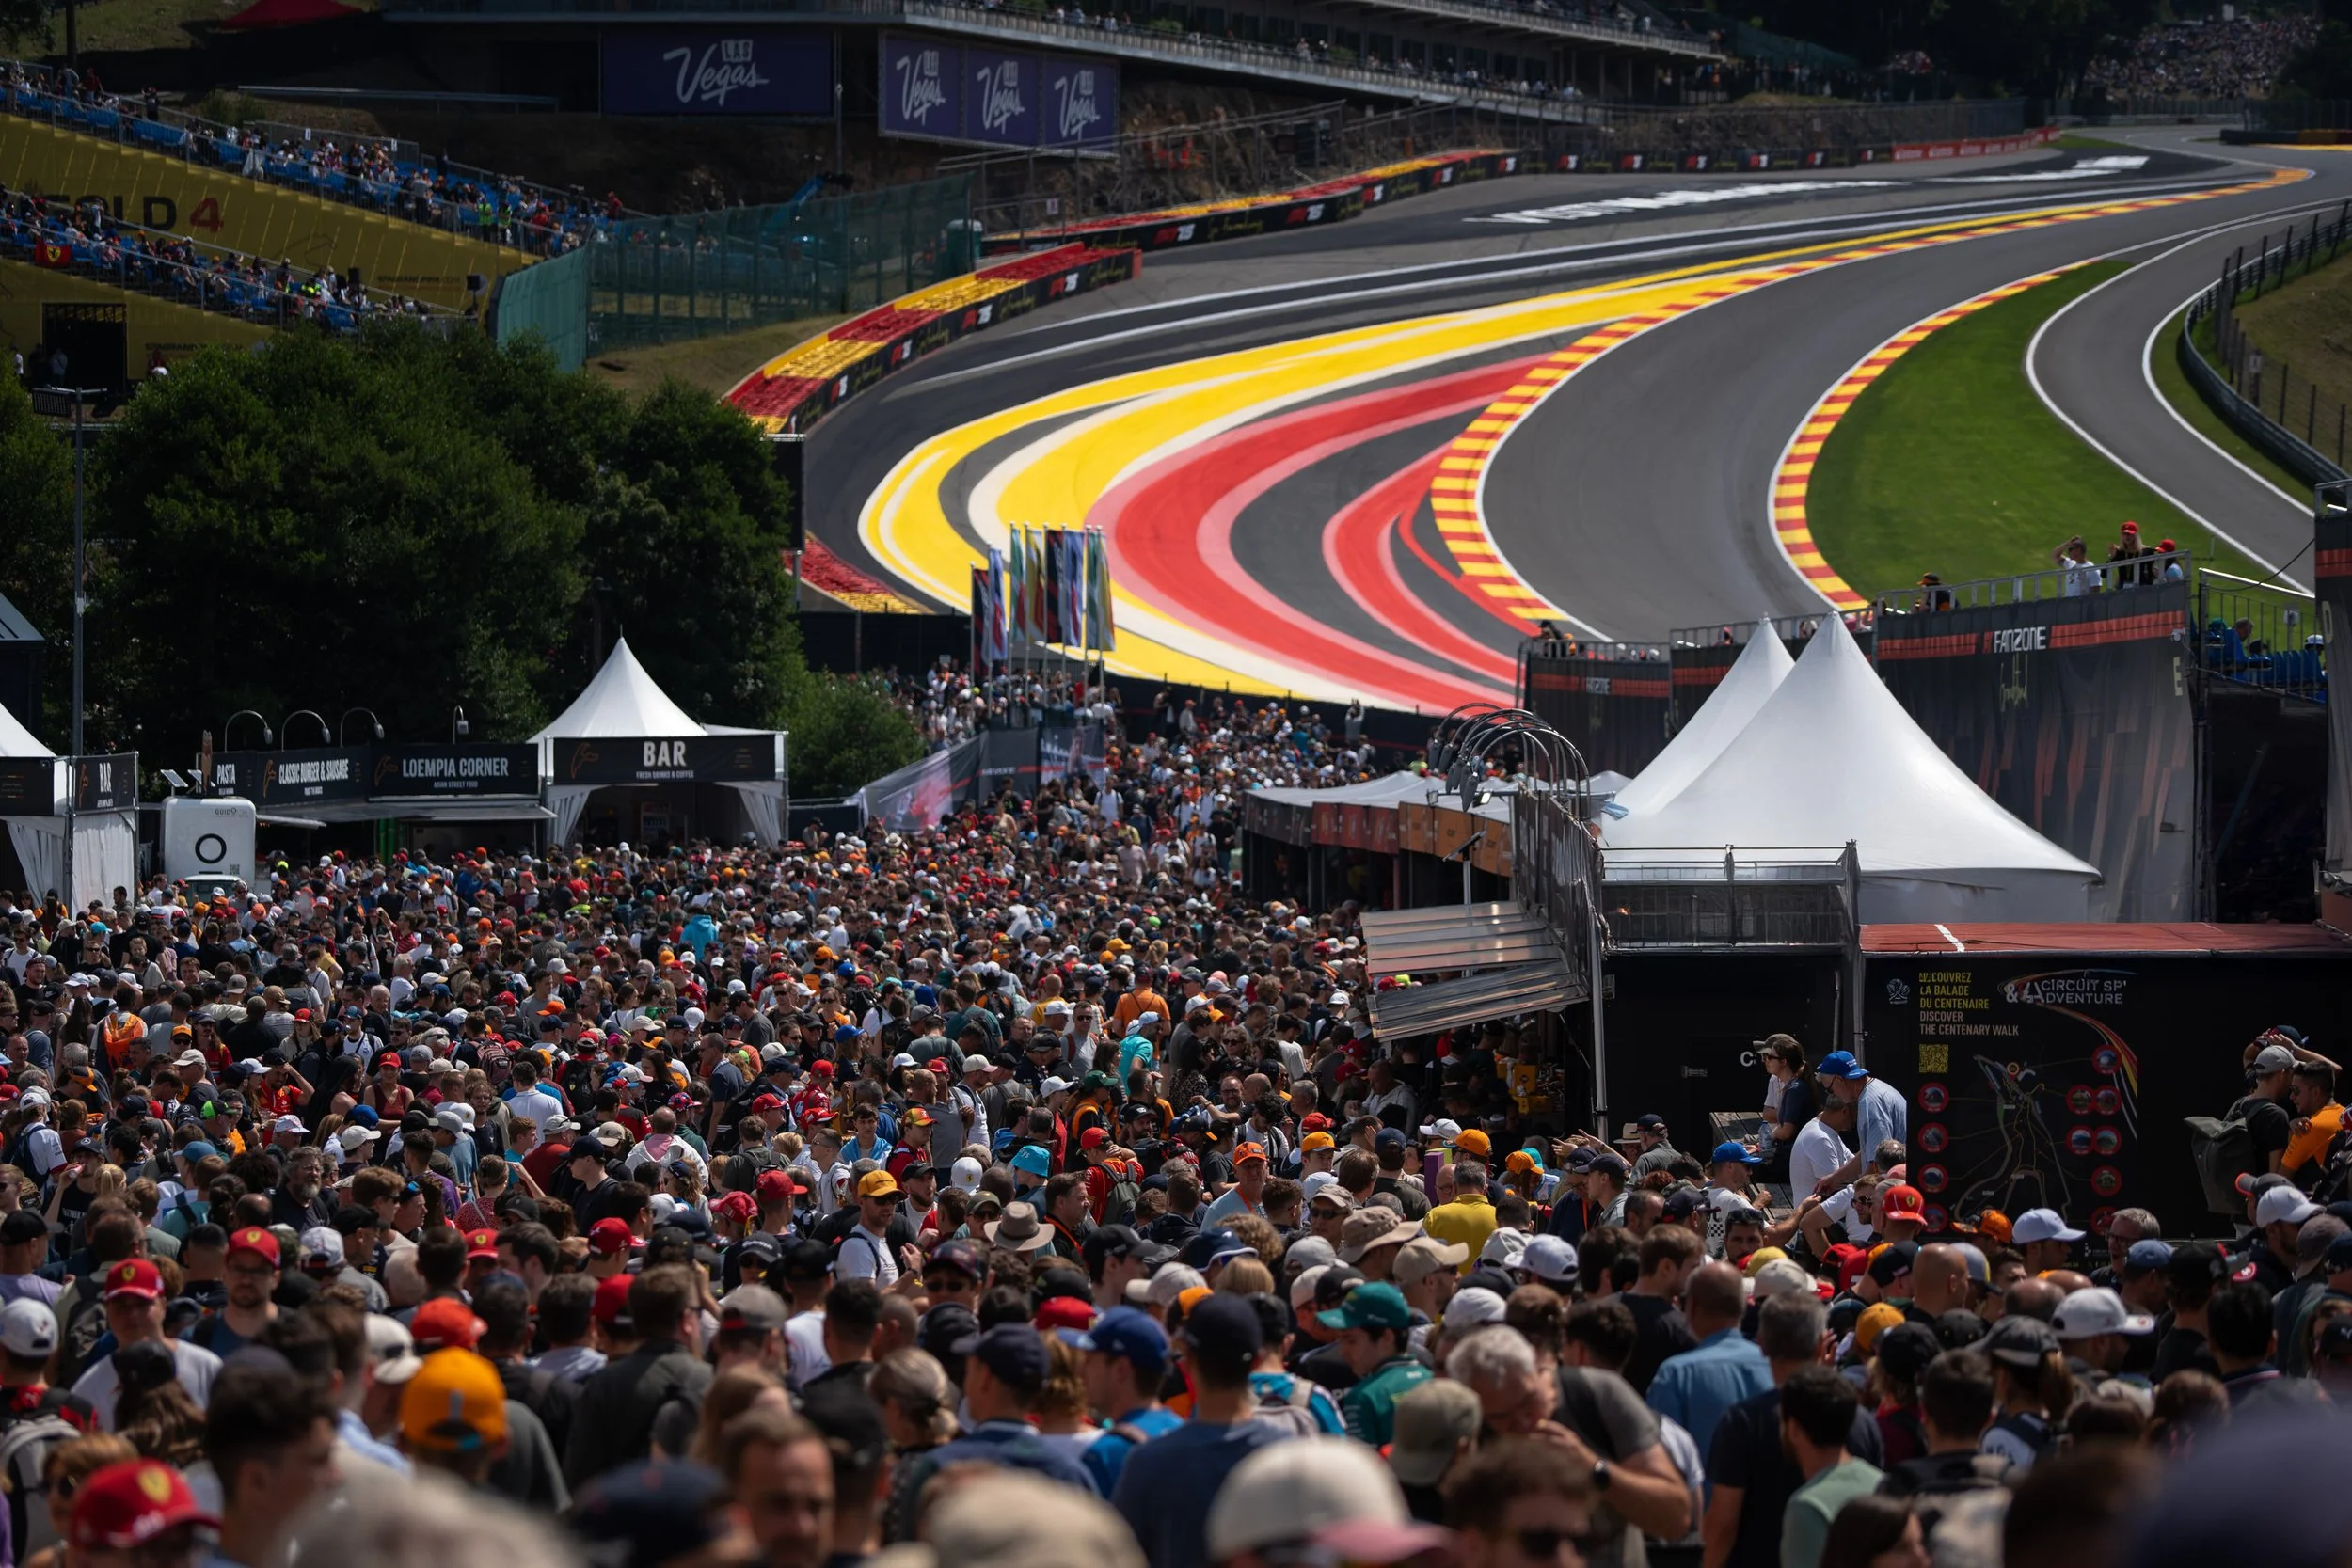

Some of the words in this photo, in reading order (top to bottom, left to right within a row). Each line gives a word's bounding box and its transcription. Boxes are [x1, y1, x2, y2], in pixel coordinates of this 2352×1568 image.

[723, 40, 752, 60] LAS
[663, 43, 770, 106] Vegas
[897, 54, 946, 125] Vegas
[977, 63, 1025, 134] Vegas
[1054, 73, 1100, 142] Vegas
[190, 198, 224, 232] 4
[1994, 626, 2046, 654] FANZONE
[644, 741, 687, 767] BAR
[99, 762, 112, 793] BAR
[217, 763, 236, 784] PASTA
[278, 763, 299, 785] CLASSIC
[300, 761, 320, 784] BURGER
[321, 760, 326, 782] &
[326, 758, 349, 781] SAUSAGE
[403, 758, 456, 778] LOEMPIA
[459, 757, 509, 777] CORNER
[1919, 985, 1931, 996] LA
[1933, 985, 1969, 996] BALADE
[2041, 979, 2100, 991] CIRCUIT
[1919, 1011, 1963, 1022] DISCOVER
[1920, 998, 1932, 1008] DU
[1934, 998, 1990, 1009] CENTENAIRE
[1919, 1024, 1936, 1036] THE
[1938, 1024, 1991, 1036] CENTENARY
[1992, 1025, 2020, 1037] WALK
